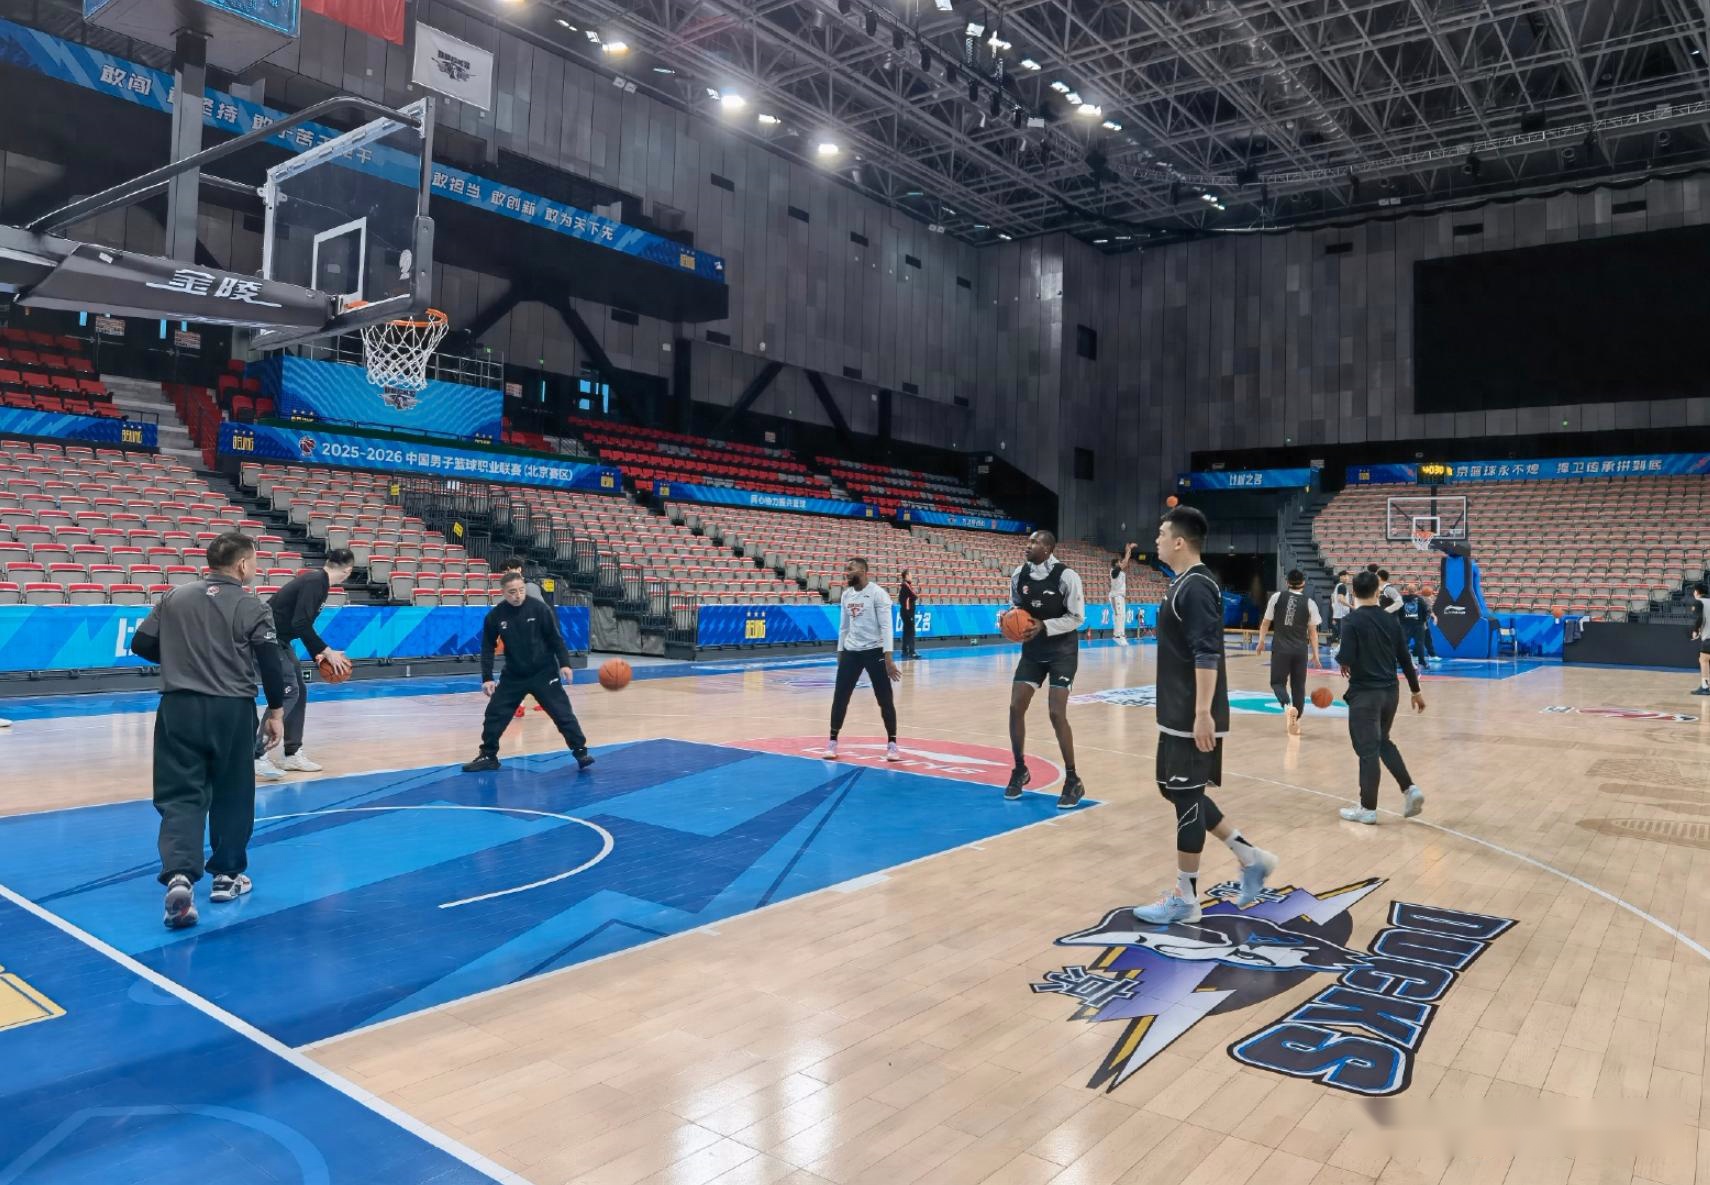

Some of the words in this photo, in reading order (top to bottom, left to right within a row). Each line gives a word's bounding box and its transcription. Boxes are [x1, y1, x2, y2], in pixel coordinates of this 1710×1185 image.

[100, 63, 153, 96] 敢闯
[432, 171, 481, 199] 敢担当
[490, 189, 537, 217] 敢创新
[544, 206, 614, 241] 敢为天下先
[145, 268, 282, 308] 金陵
[1227, 899, 1520, 1097] DUCKS
